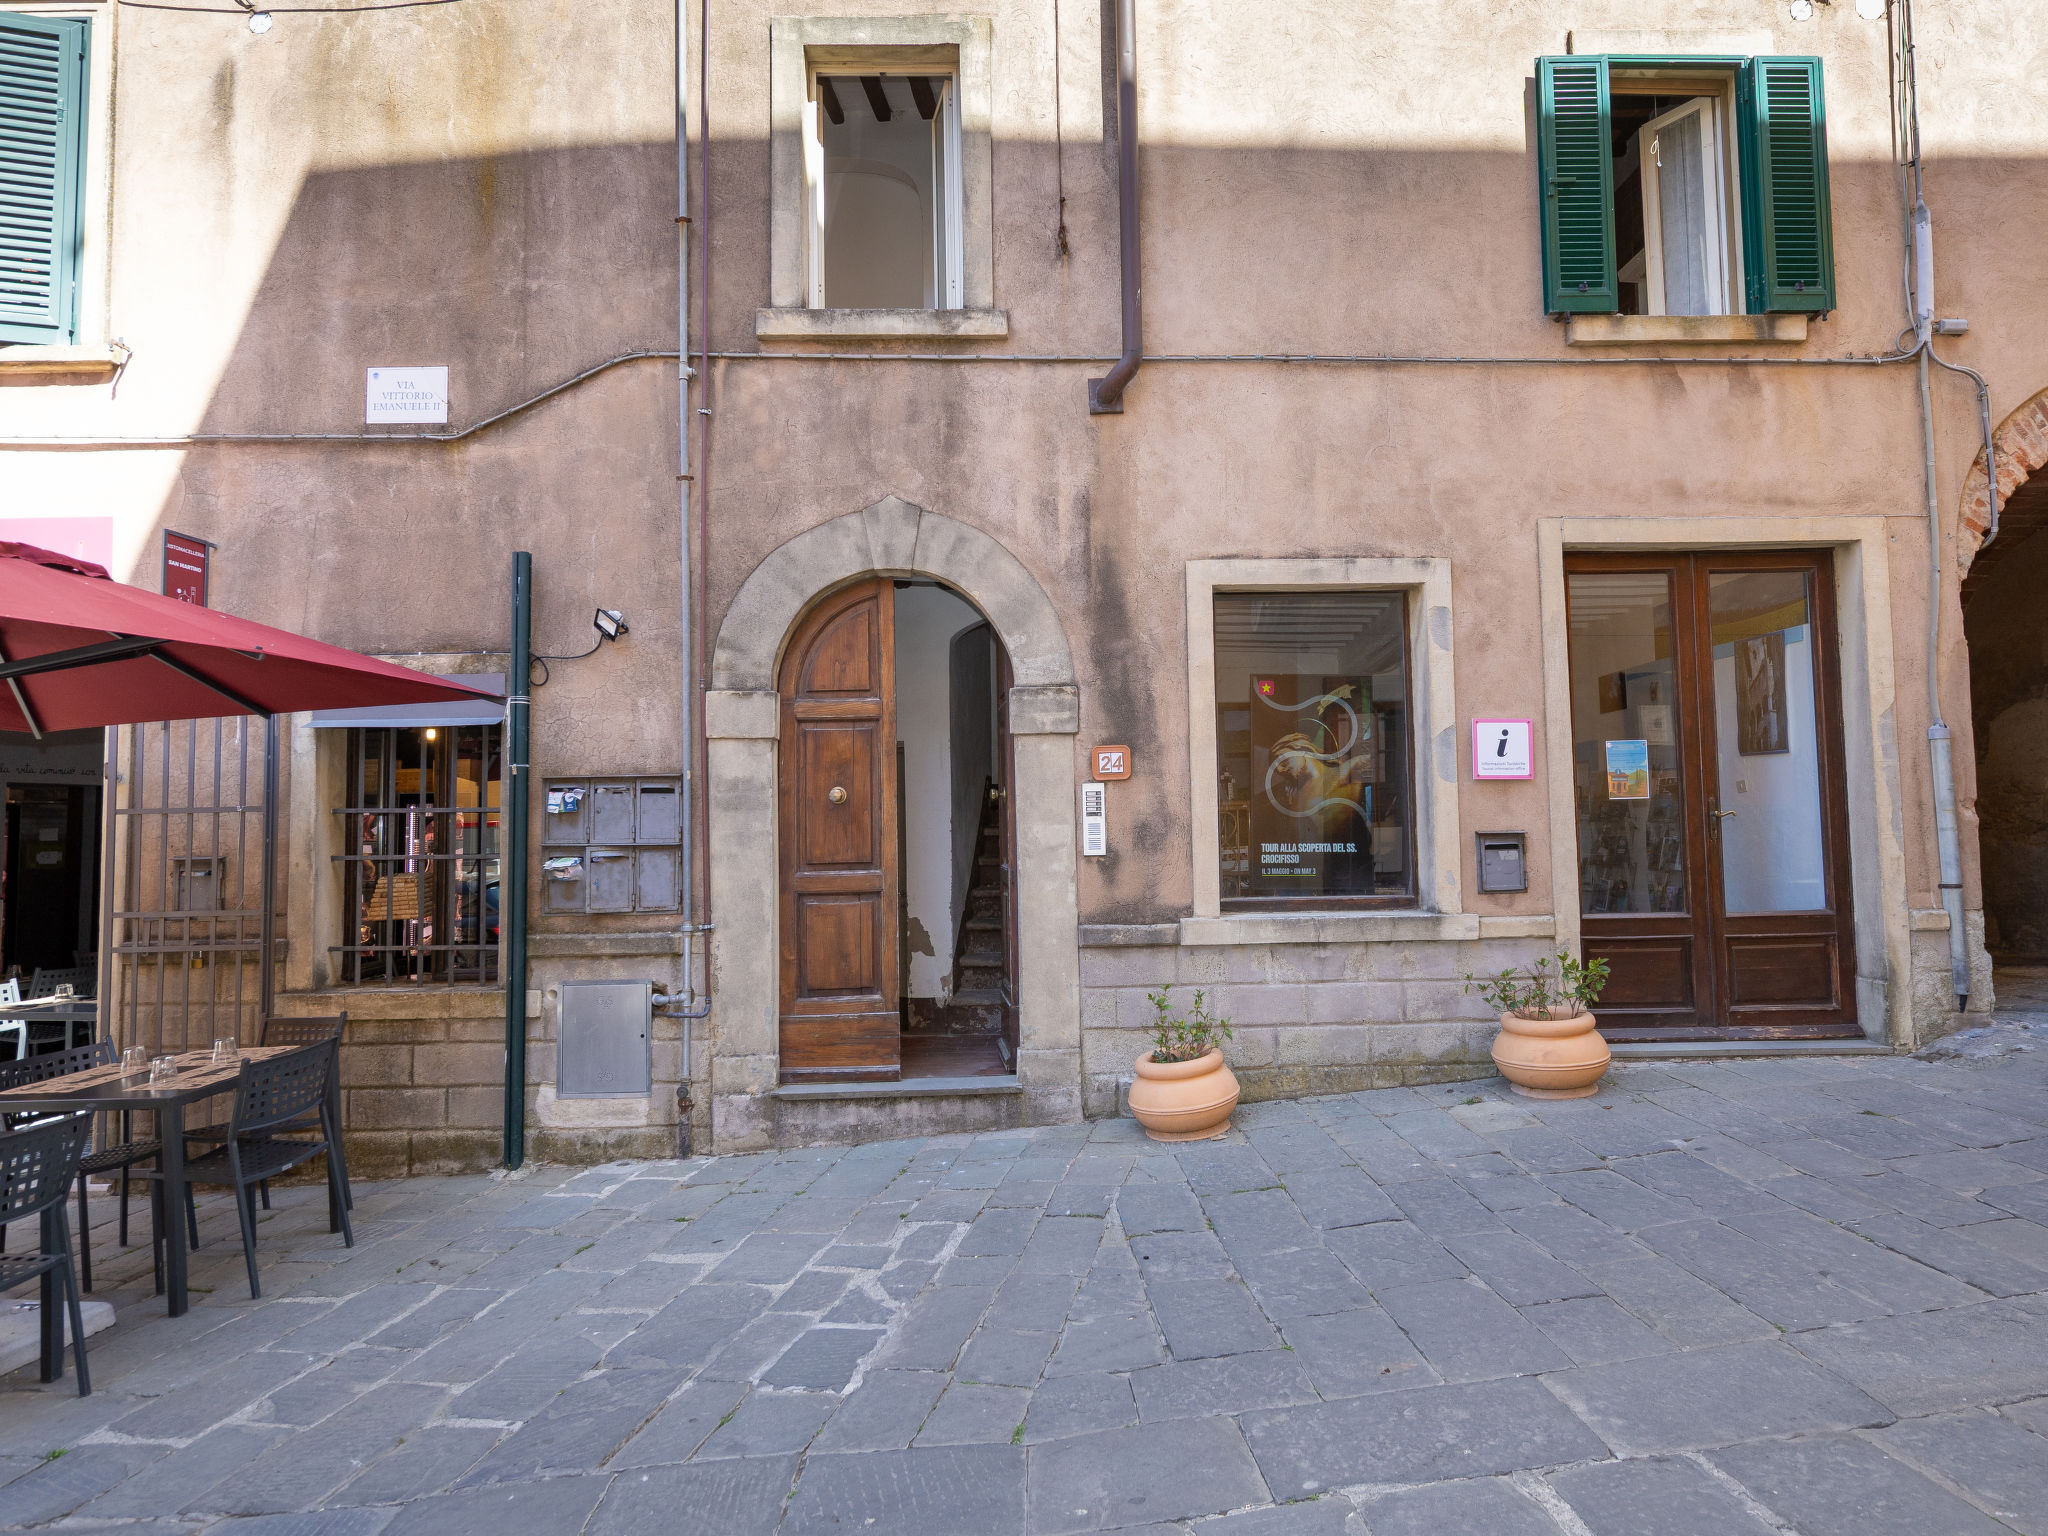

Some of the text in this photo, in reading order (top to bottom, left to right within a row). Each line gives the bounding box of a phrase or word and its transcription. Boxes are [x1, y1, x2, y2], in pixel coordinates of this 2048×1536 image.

[397, 381, 415, 389] VIA
[382, 391, 433, 400] VITTORIO
[373, 402, 440, 411] EMANUELE II
[168, 559, 202, 573] SAN MARTINO
[1100, 755, 1123, 772] 24
[1260, 843, 1358, 853] TOUR ALLA SCOPERTA DEL SS.
[1261, 854, 1300, 864] CROCIFISSO
[1261, 867, 1267, 875] IL
[1271, 867, 1290, 875] MAGGIO
[1293, 867, 1301, 875] ON
[1301, 867, 1312, 875] MAY
